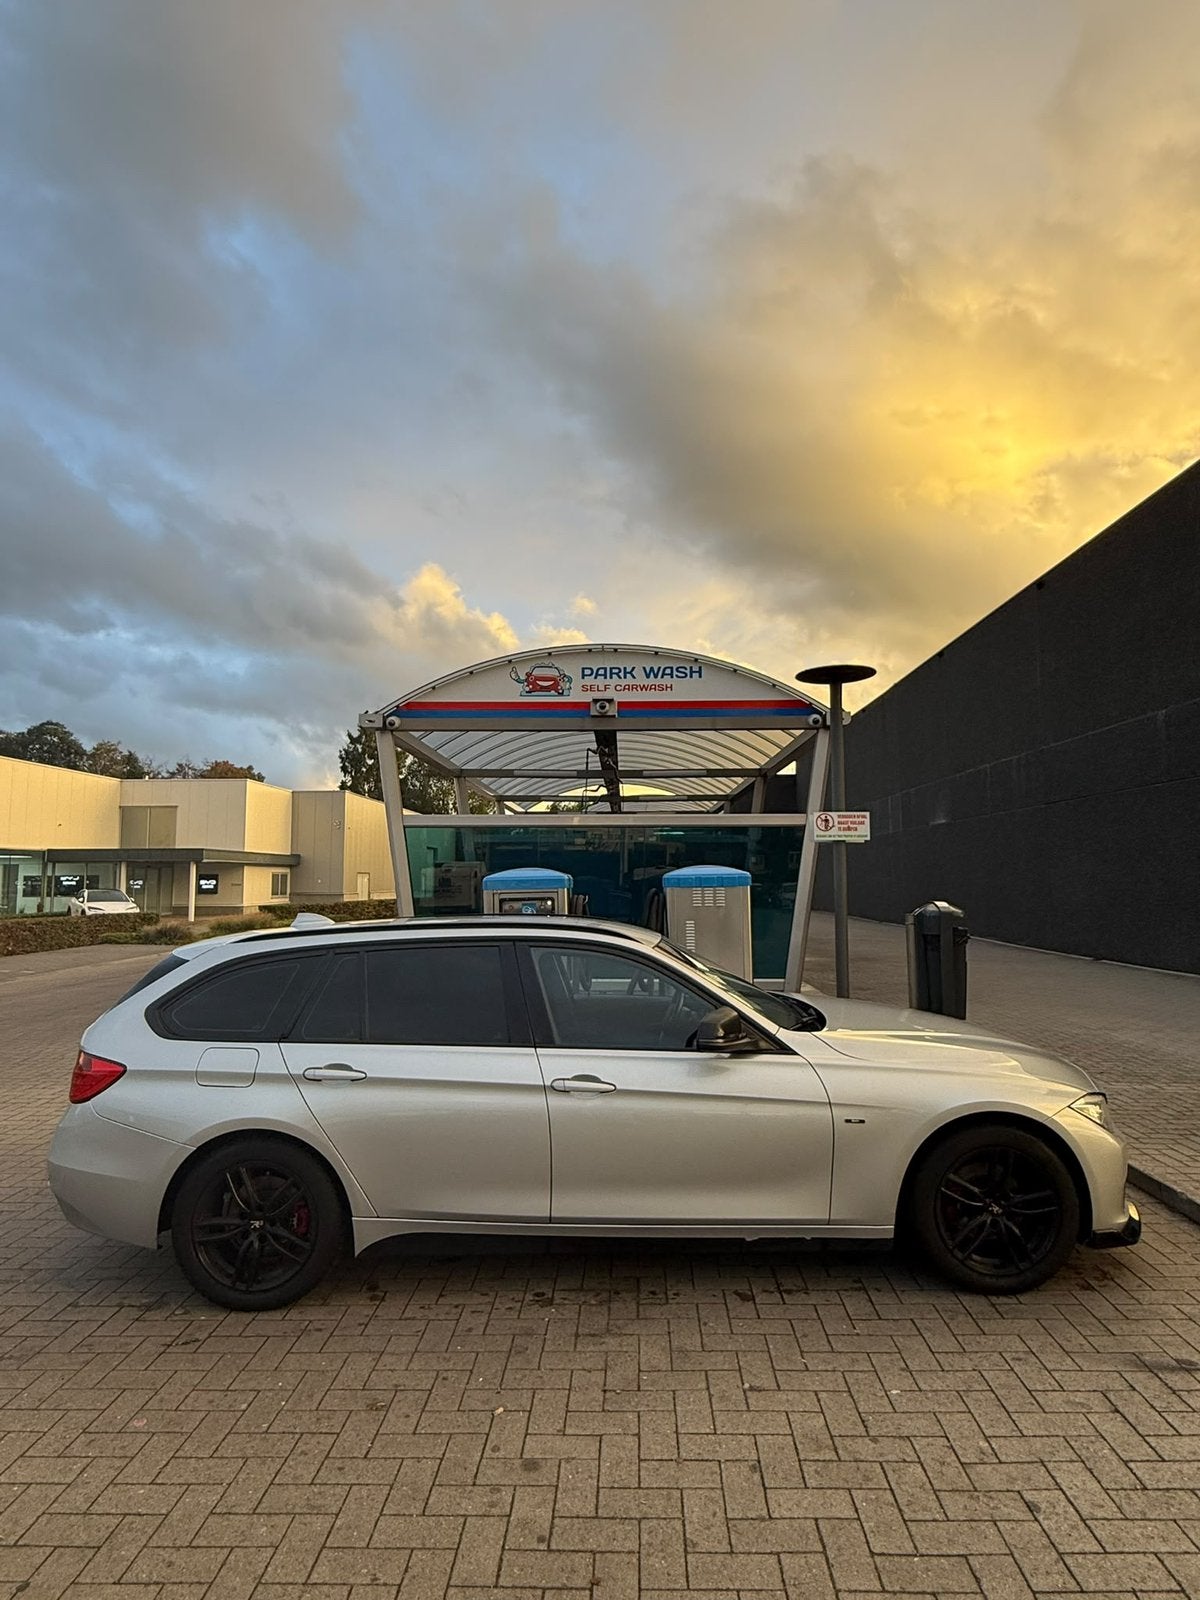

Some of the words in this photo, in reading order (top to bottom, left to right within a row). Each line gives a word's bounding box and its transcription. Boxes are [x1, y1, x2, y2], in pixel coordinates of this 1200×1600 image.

[581, 666, 636, 680] PARK
[642, 665, 703, 679] WASH
[581, 684, 611, 692] SELF
[614, 683, 673, 692] CARWASH
